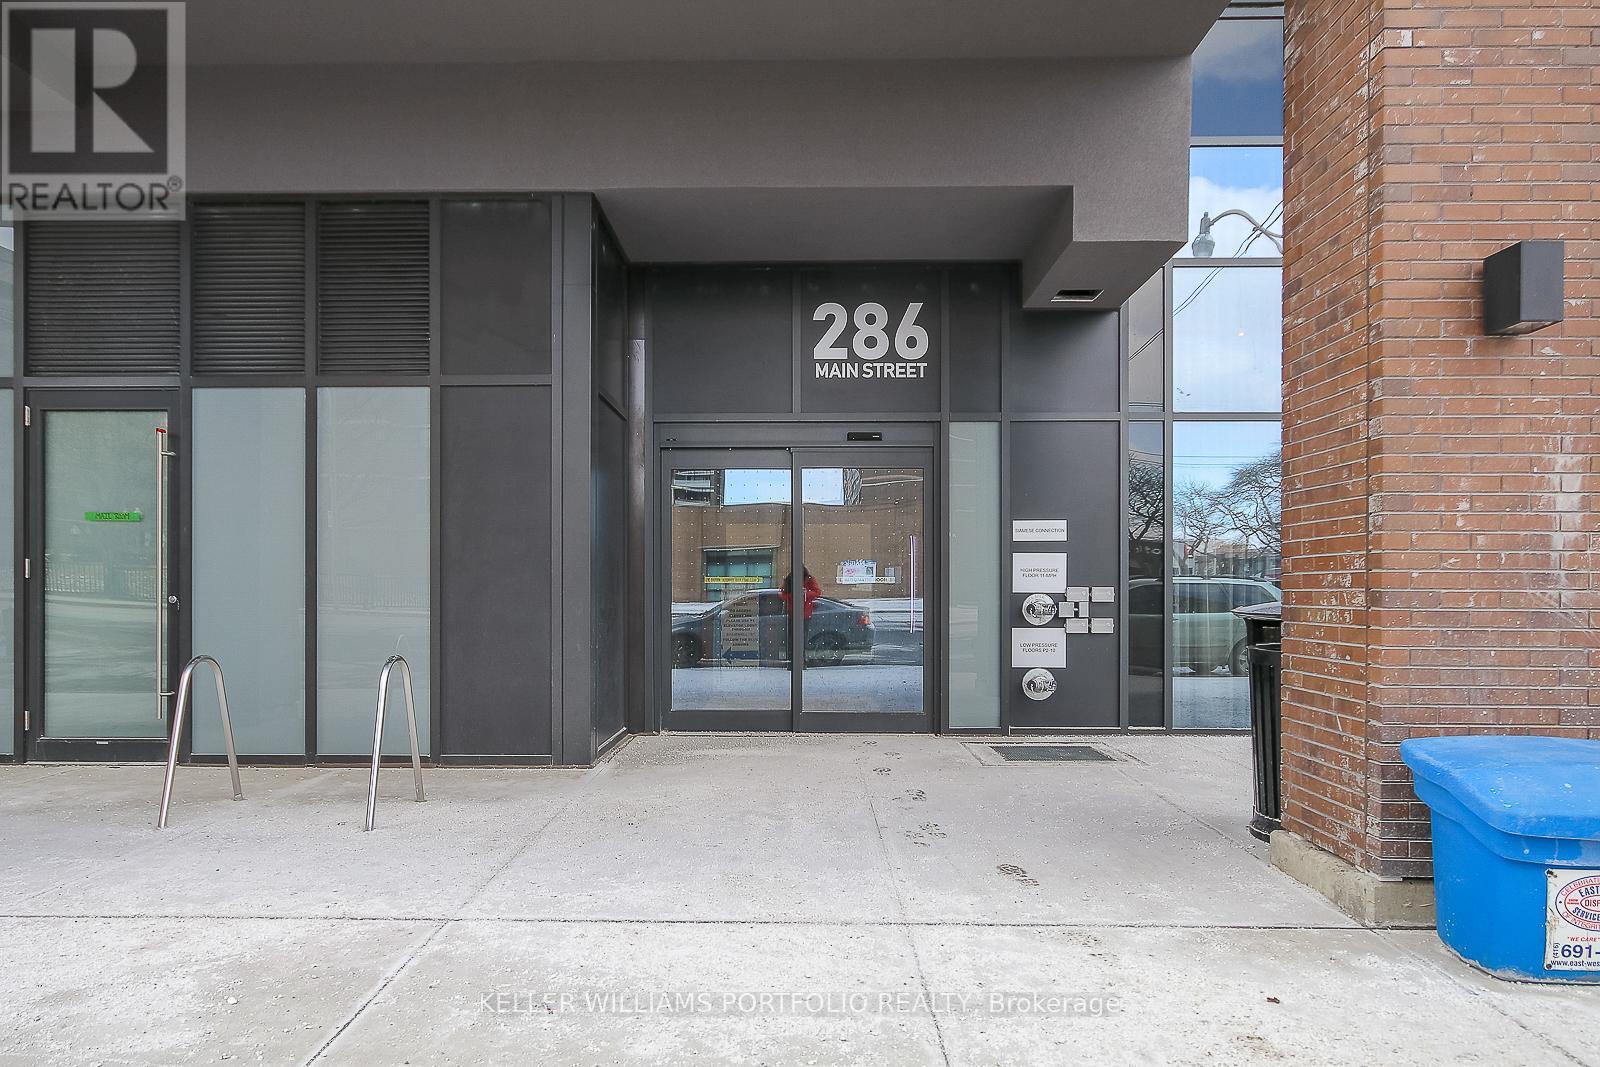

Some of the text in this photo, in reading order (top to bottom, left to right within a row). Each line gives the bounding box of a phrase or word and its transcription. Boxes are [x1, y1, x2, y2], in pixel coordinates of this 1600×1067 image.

[813, 302, 929, 360] 286
[815, 362, 928, 379] MAIN STREET
[1579, 885, 1600, 897] EAST
